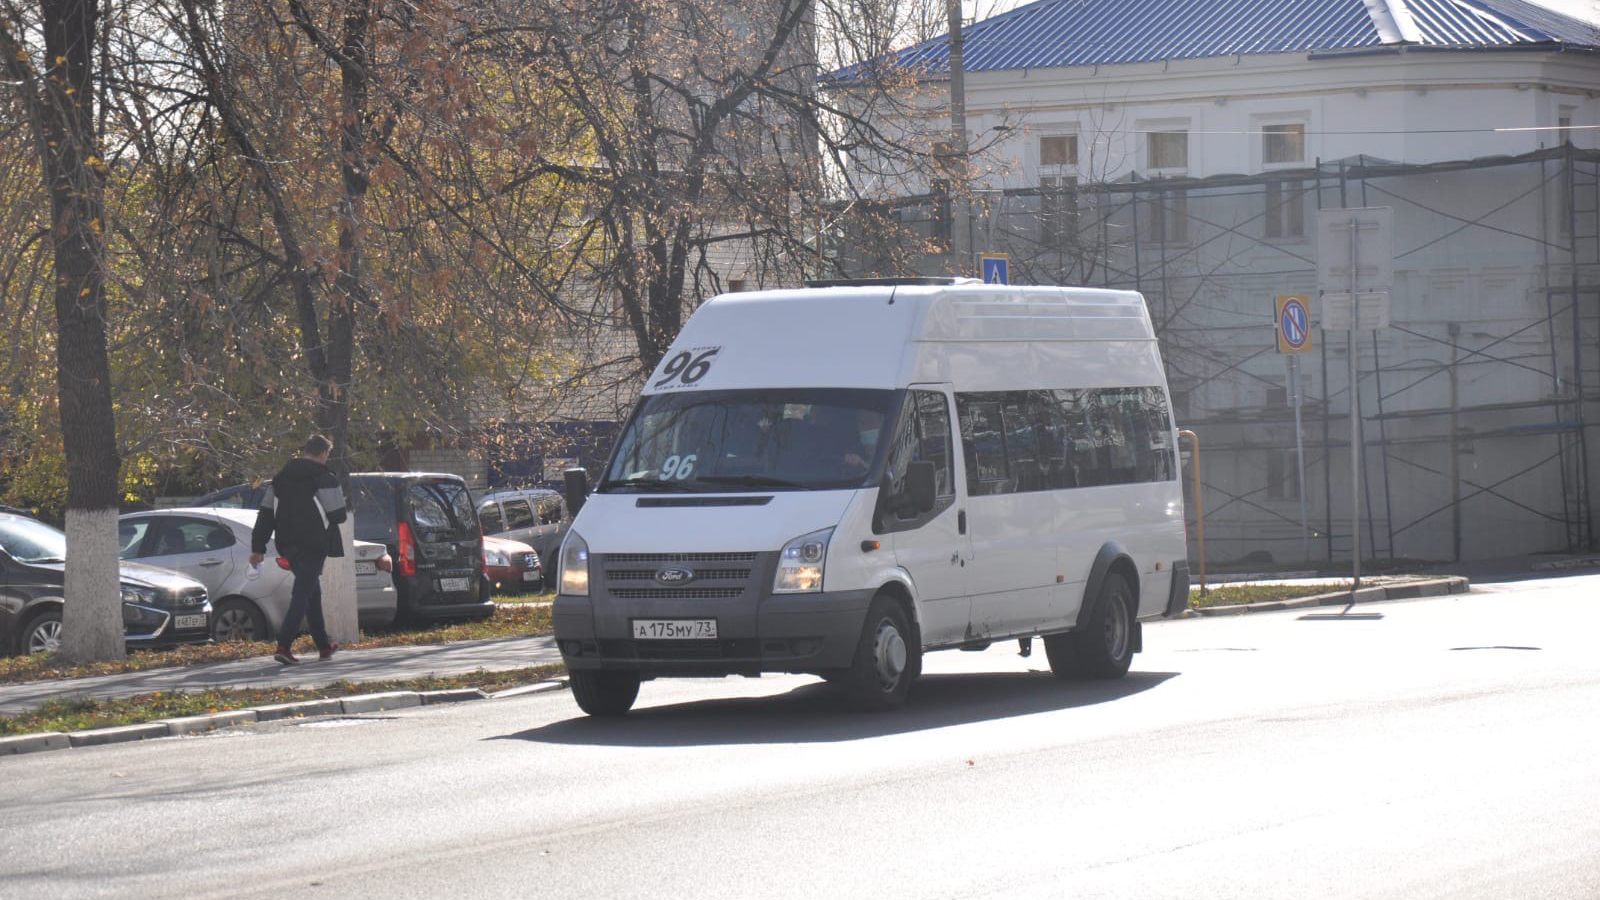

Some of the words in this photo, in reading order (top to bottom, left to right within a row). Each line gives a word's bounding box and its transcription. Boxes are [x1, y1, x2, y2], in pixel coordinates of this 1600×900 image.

[654, 348, 720, 387] 96
[659, 454, 697, 481] 96
[662, 570, 683, 581] Ford
